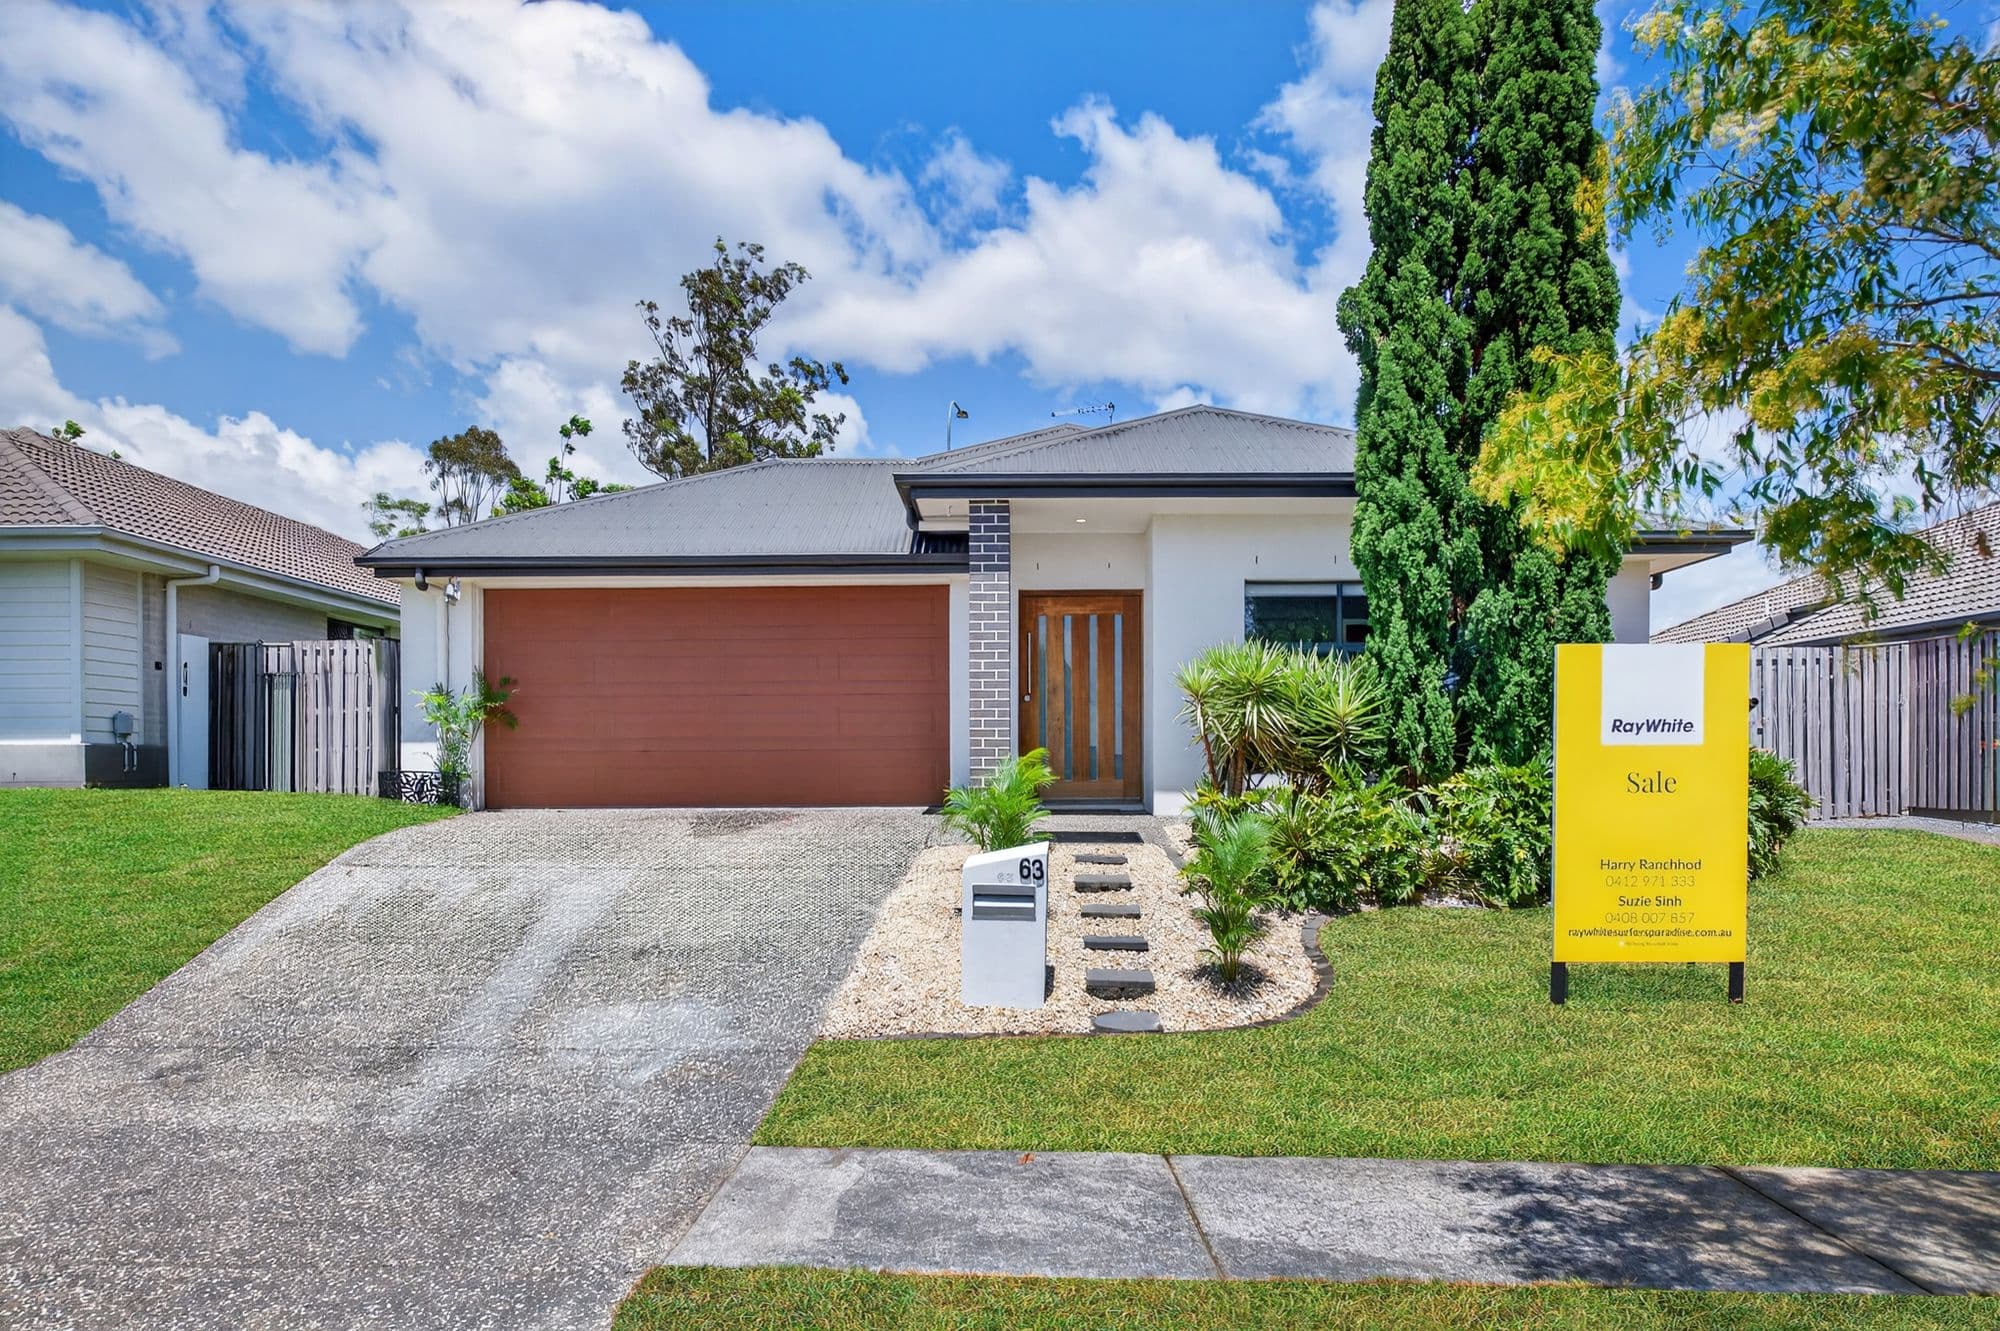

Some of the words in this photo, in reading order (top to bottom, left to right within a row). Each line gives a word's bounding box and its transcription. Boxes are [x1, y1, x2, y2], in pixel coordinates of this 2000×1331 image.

[1627, 771, 1677, 794] Sale
[1020, 858, 1044, 880] 63
[1600, 859, 1636, 872] Harry
[1640, 859, 1701, 870] Ranchhod
[1605, 876, 1639, 887] 0412
[1643, 876, 1665, 887] 971
[1671, 876, 1696, 887] 333
[1618, 896, 1651, 907] Suzie
[1655, 896, 1682, 907] Sinh
[1605, 912, 1638, 924] 0408
[1641, 912, 1666, 924] 007
